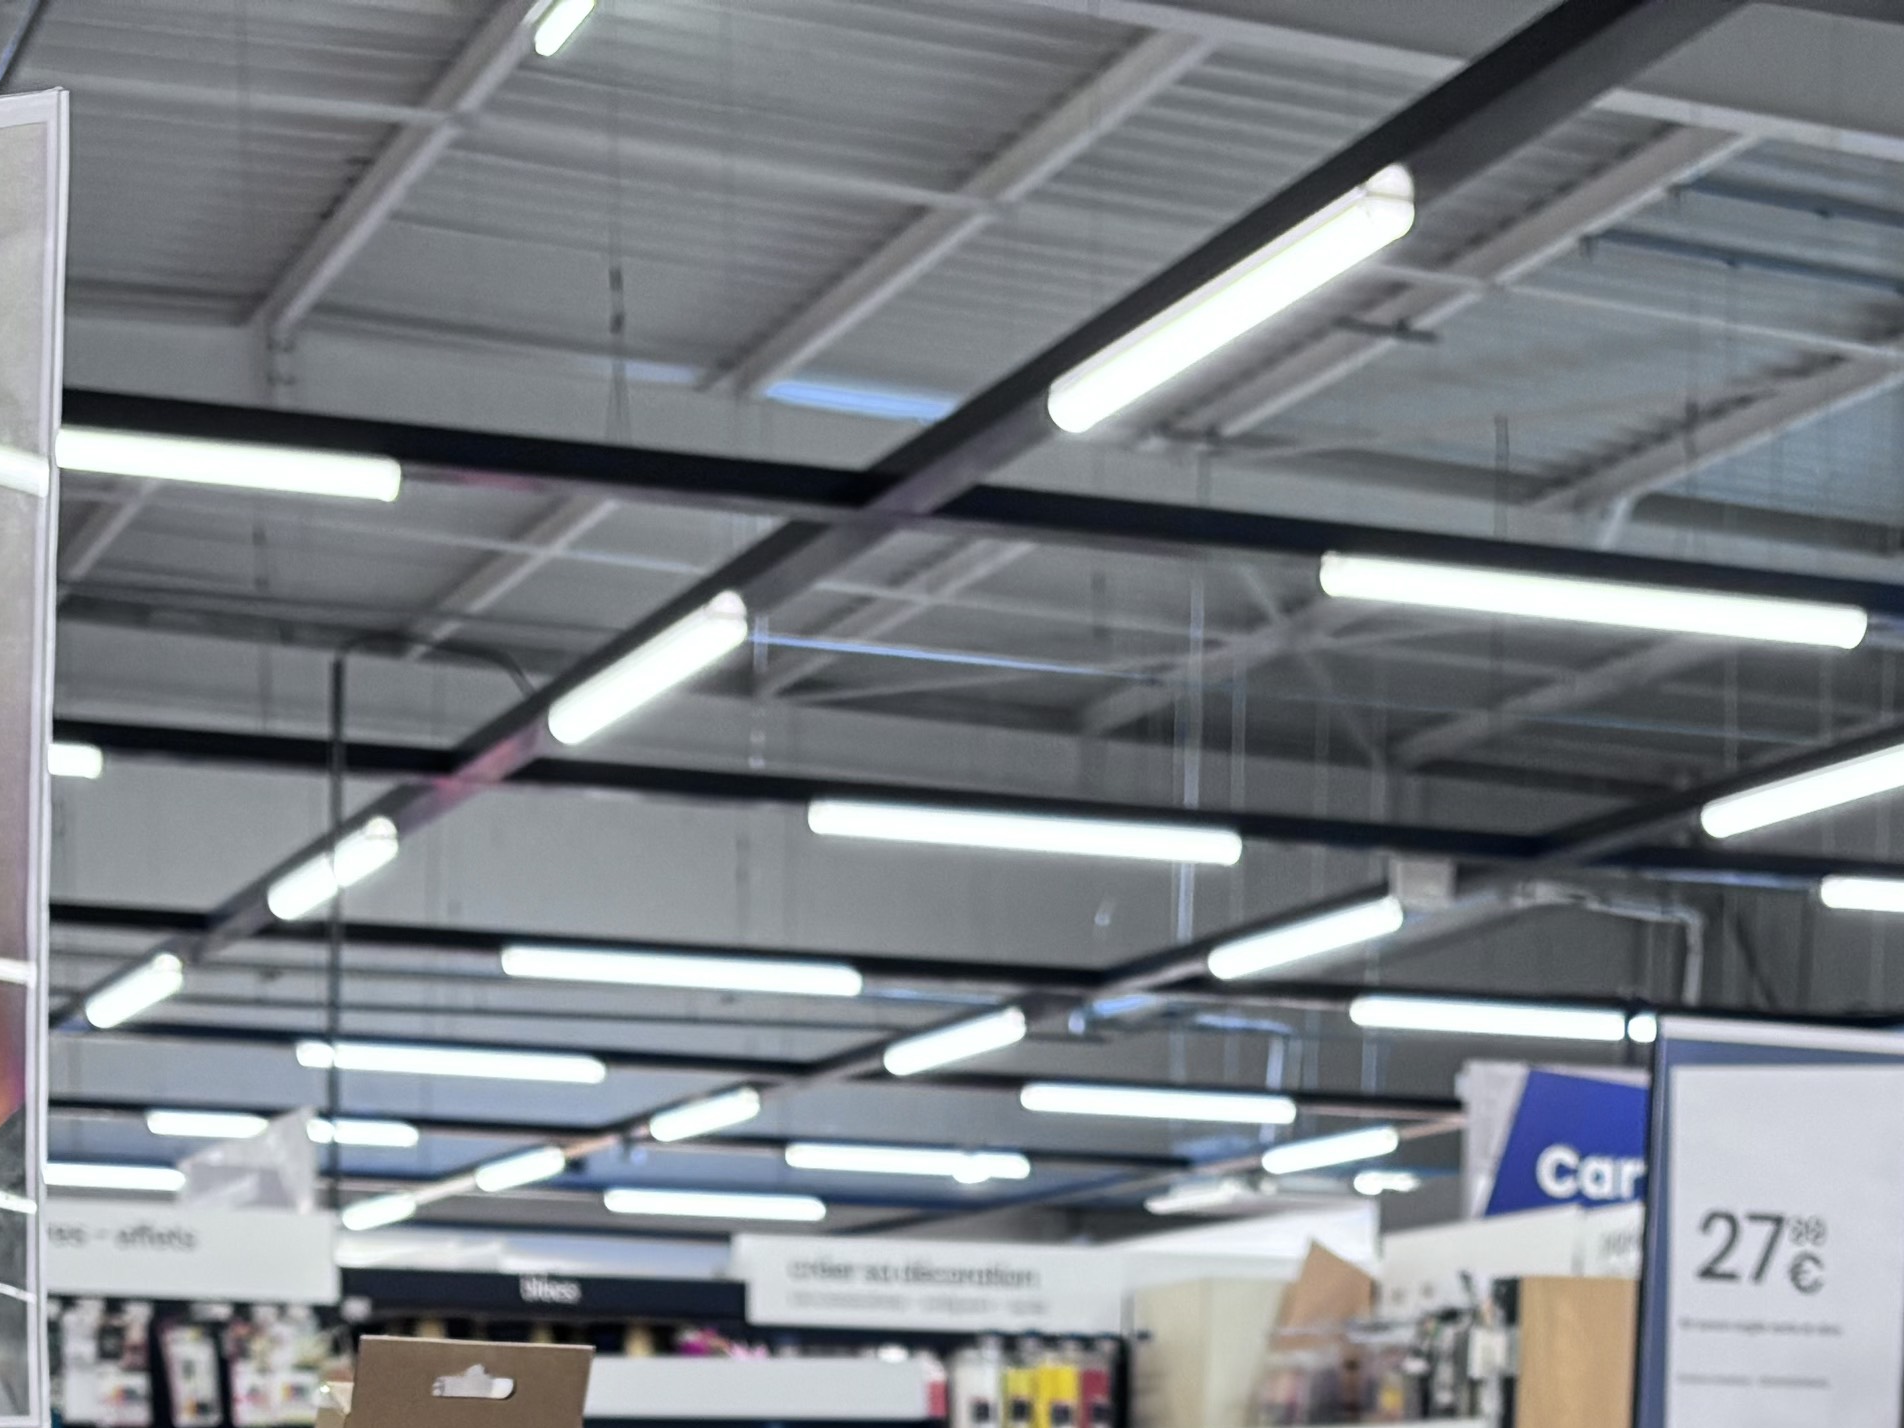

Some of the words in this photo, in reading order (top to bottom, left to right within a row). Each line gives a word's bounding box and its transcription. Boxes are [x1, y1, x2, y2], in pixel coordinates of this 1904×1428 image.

[1536, 1144, 1646, 1200] Car
[1696, 1210, 1786, 1284] 27
[1789, 1252, 1825, 1294] €
